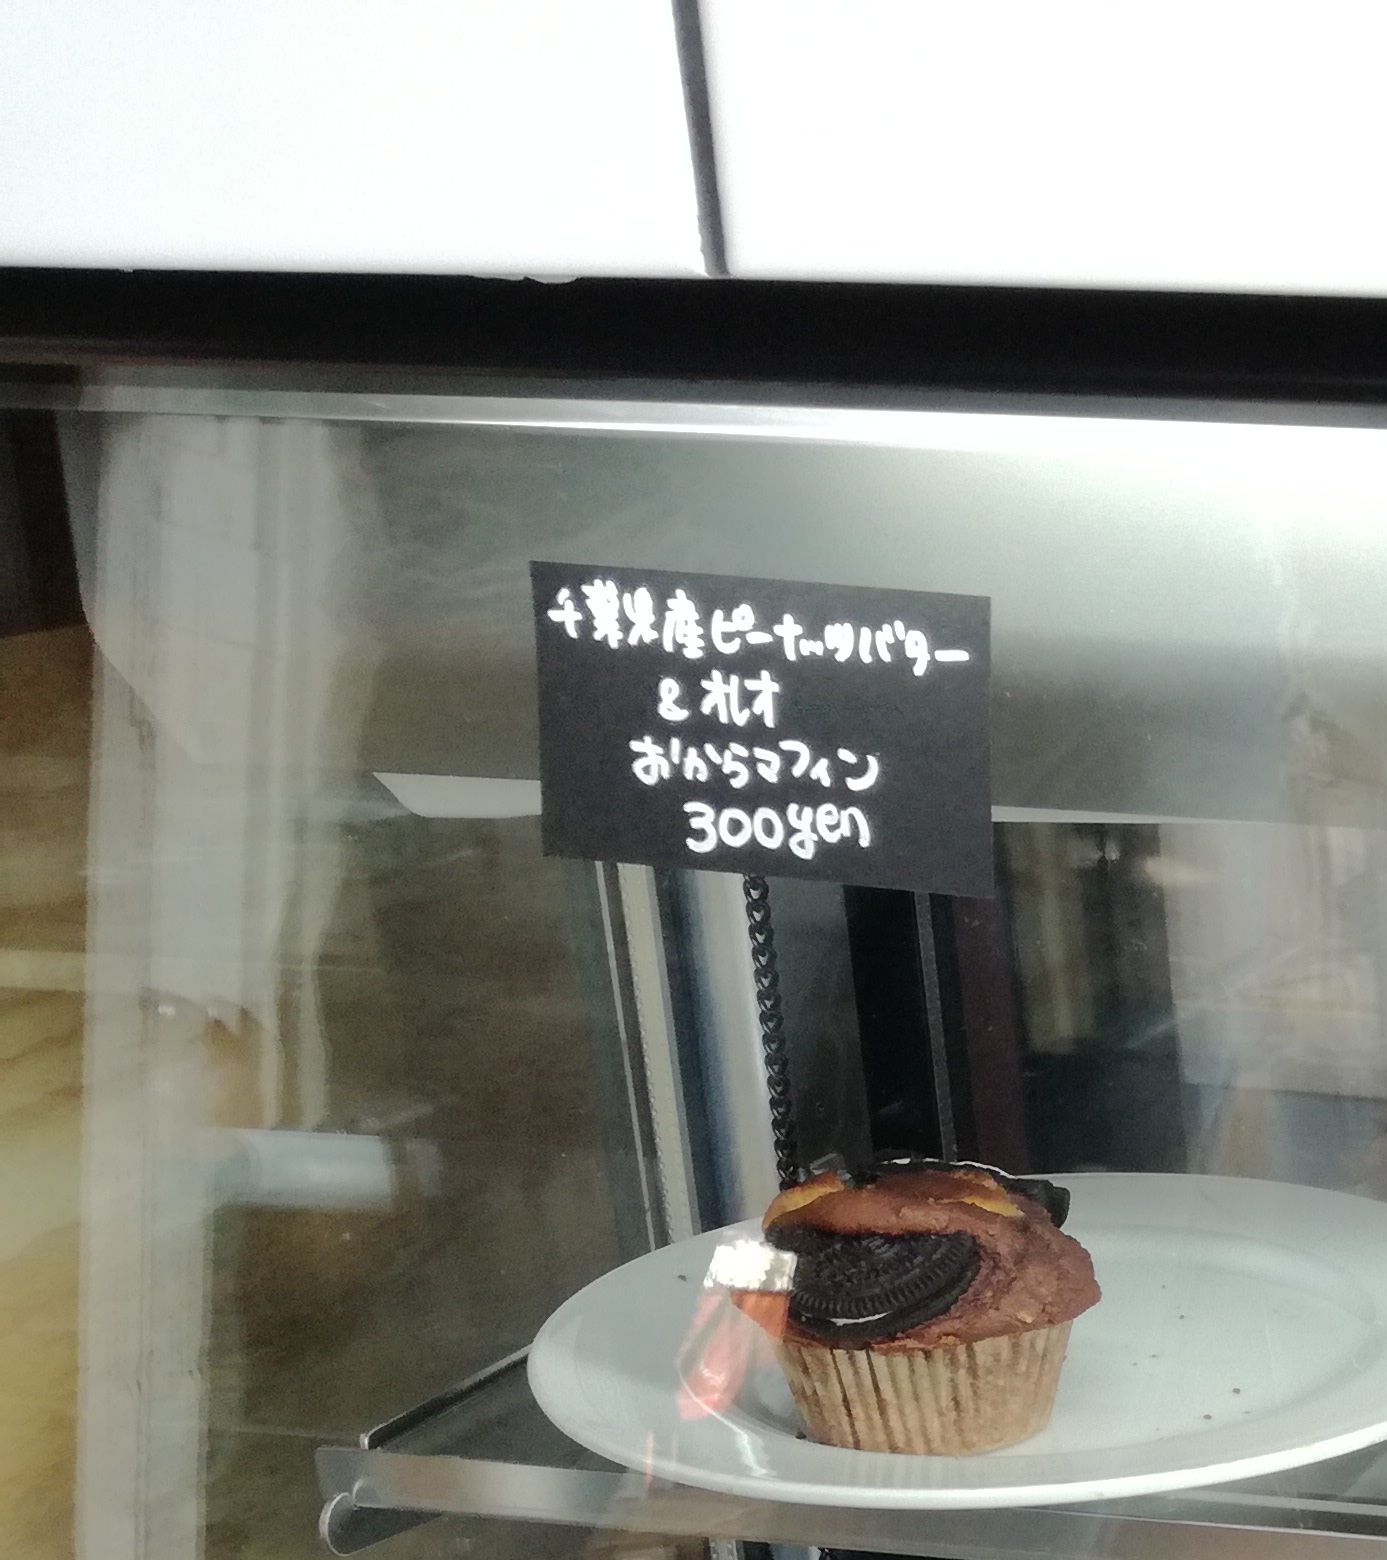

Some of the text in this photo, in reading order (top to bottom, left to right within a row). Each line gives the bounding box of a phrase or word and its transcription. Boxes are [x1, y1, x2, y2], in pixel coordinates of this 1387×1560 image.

[629, 736, 879, 790] おからマフィン
[683, 800, 871, 860] 300yen
